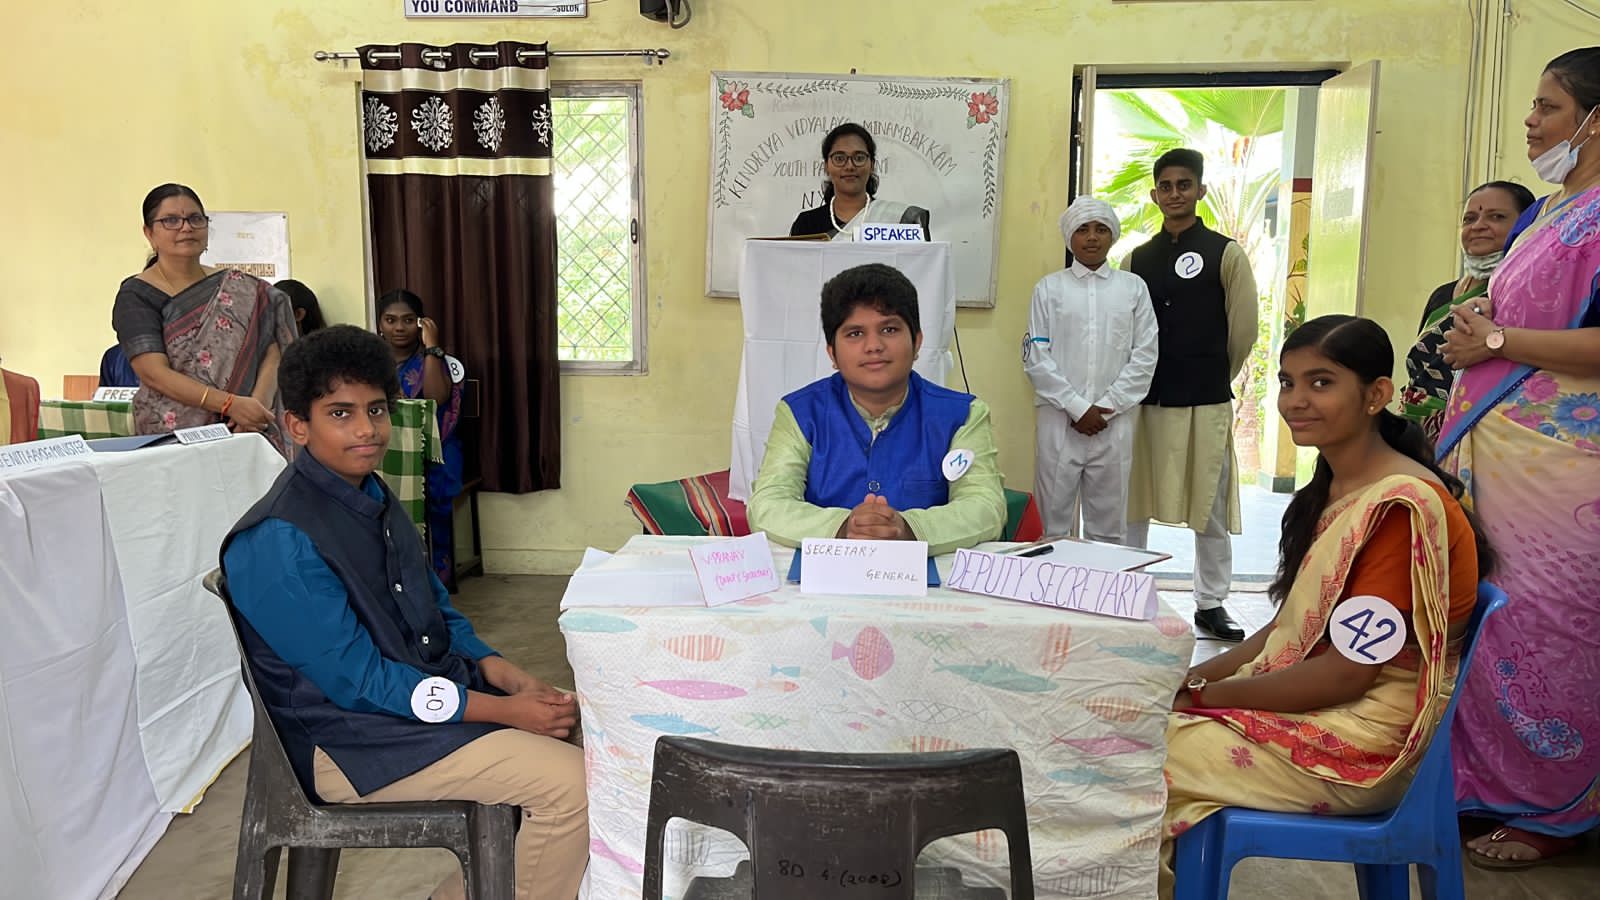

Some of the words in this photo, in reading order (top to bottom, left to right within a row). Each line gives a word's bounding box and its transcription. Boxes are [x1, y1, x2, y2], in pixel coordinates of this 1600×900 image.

[412, 0, 439, 13] YOU
[445, 0, 518, 13] COMMAND
[729, 132, 784, 199] KENDRIYA
[785, 116, 850, 138] VIDYALAY
[863, 120, 957, 176] MINAMBAKKAM
[773, 160, 808, 177] YOUTH
[864, 227, 921, 241] SPEAKER
[1181, 255, 1201, 275] 2
[805, 543, 877, 557] SECRETARY
[866, 569, 918, 582] GENERAL
[947, 550, 1033, 598] DEPUTY
[1030, 562, 1149, 617] SECRETARY
[1338, 608, 1397, 661] 42
[425, 685, 445, 711] 40
